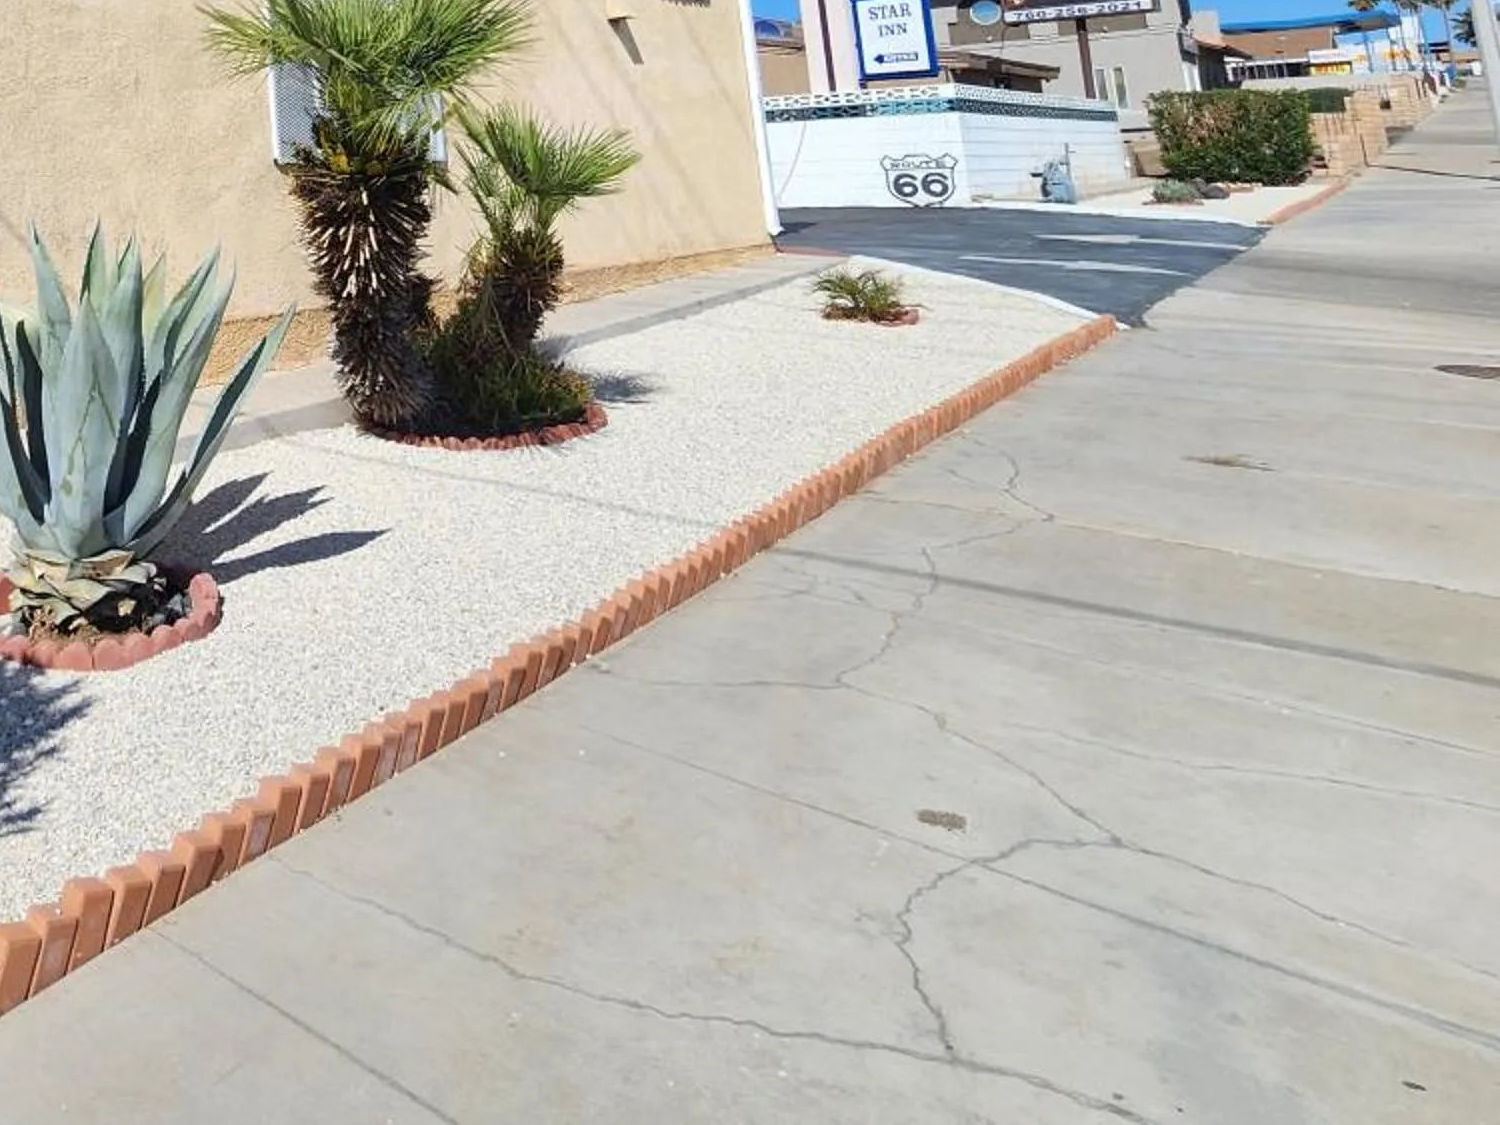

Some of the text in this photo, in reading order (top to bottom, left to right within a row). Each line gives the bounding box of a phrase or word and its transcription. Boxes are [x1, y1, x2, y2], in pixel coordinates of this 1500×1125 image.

[868, 3, 911, 20] STAR
[878, 22, 908, 37] INN
[894, 172, 949, 197] 66
